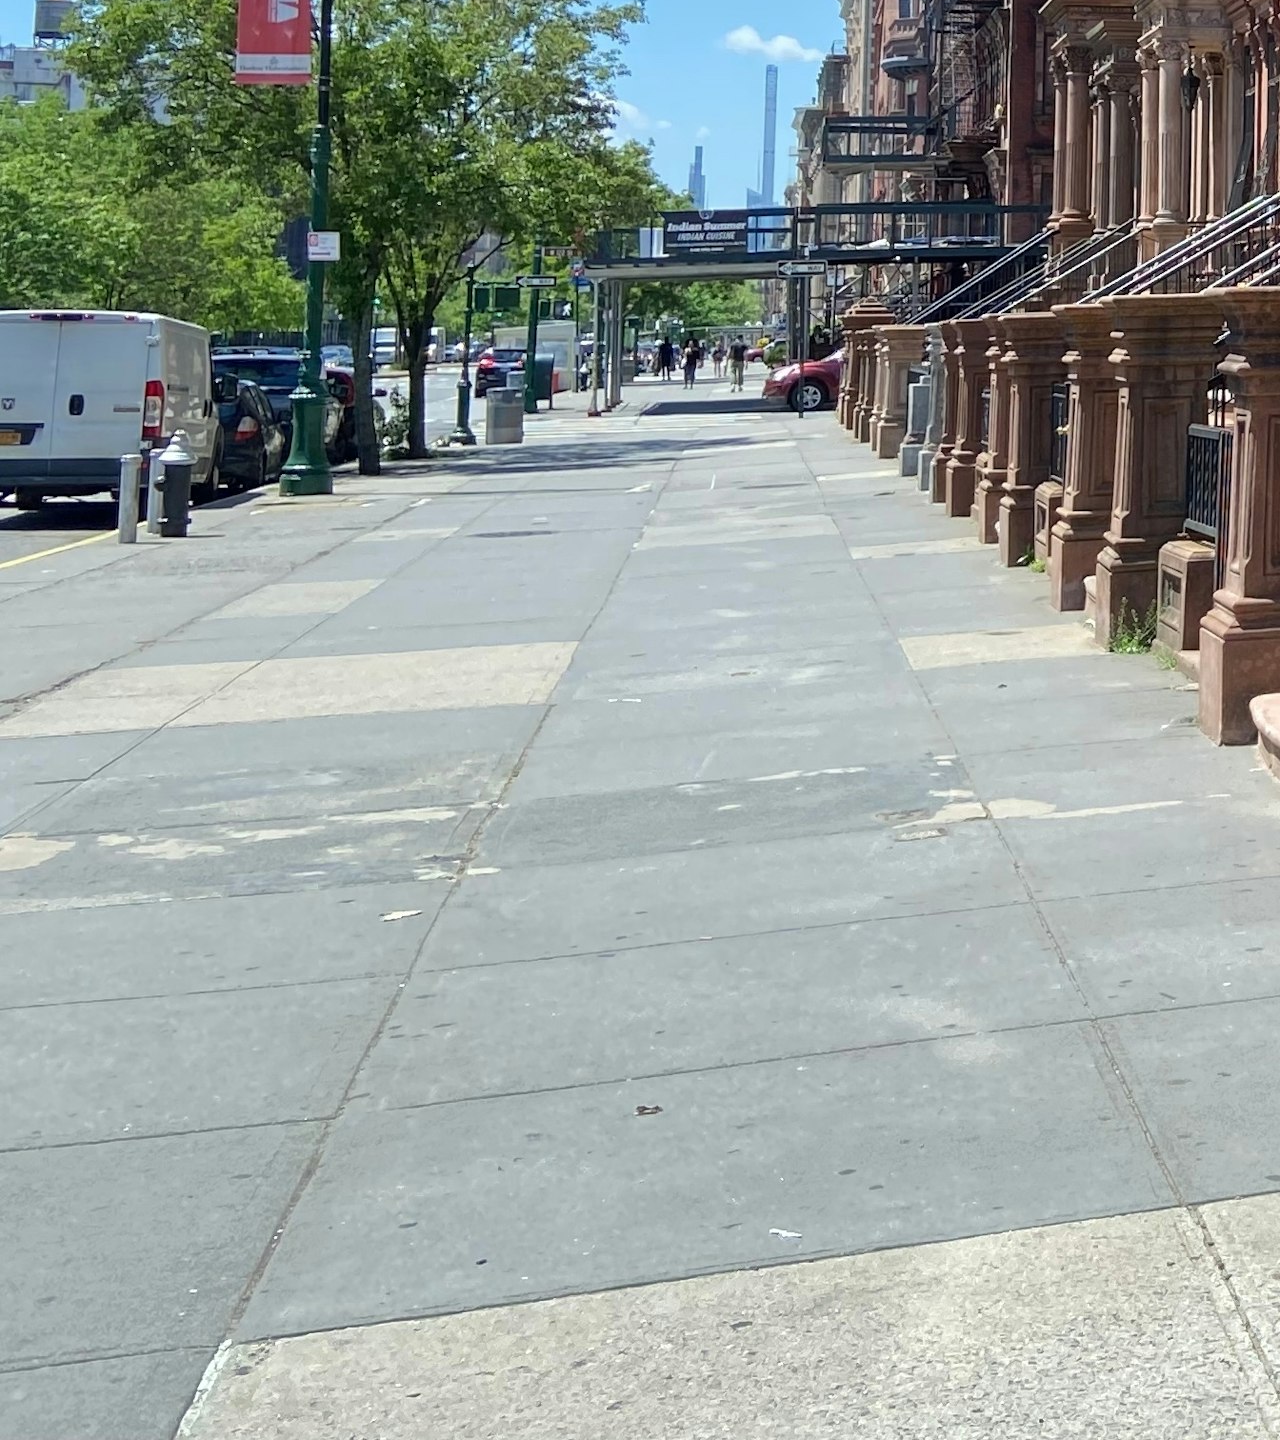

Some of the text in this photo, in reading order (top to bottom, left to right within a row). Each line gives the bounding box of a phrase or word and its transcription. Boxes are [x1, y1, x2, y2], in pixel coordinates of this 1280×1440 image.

[667, 221, 747, 232] Indian Summer
[677, 231, 736, 241] INDIAN CUISINE
[783, 265, 799, 273] ONE
